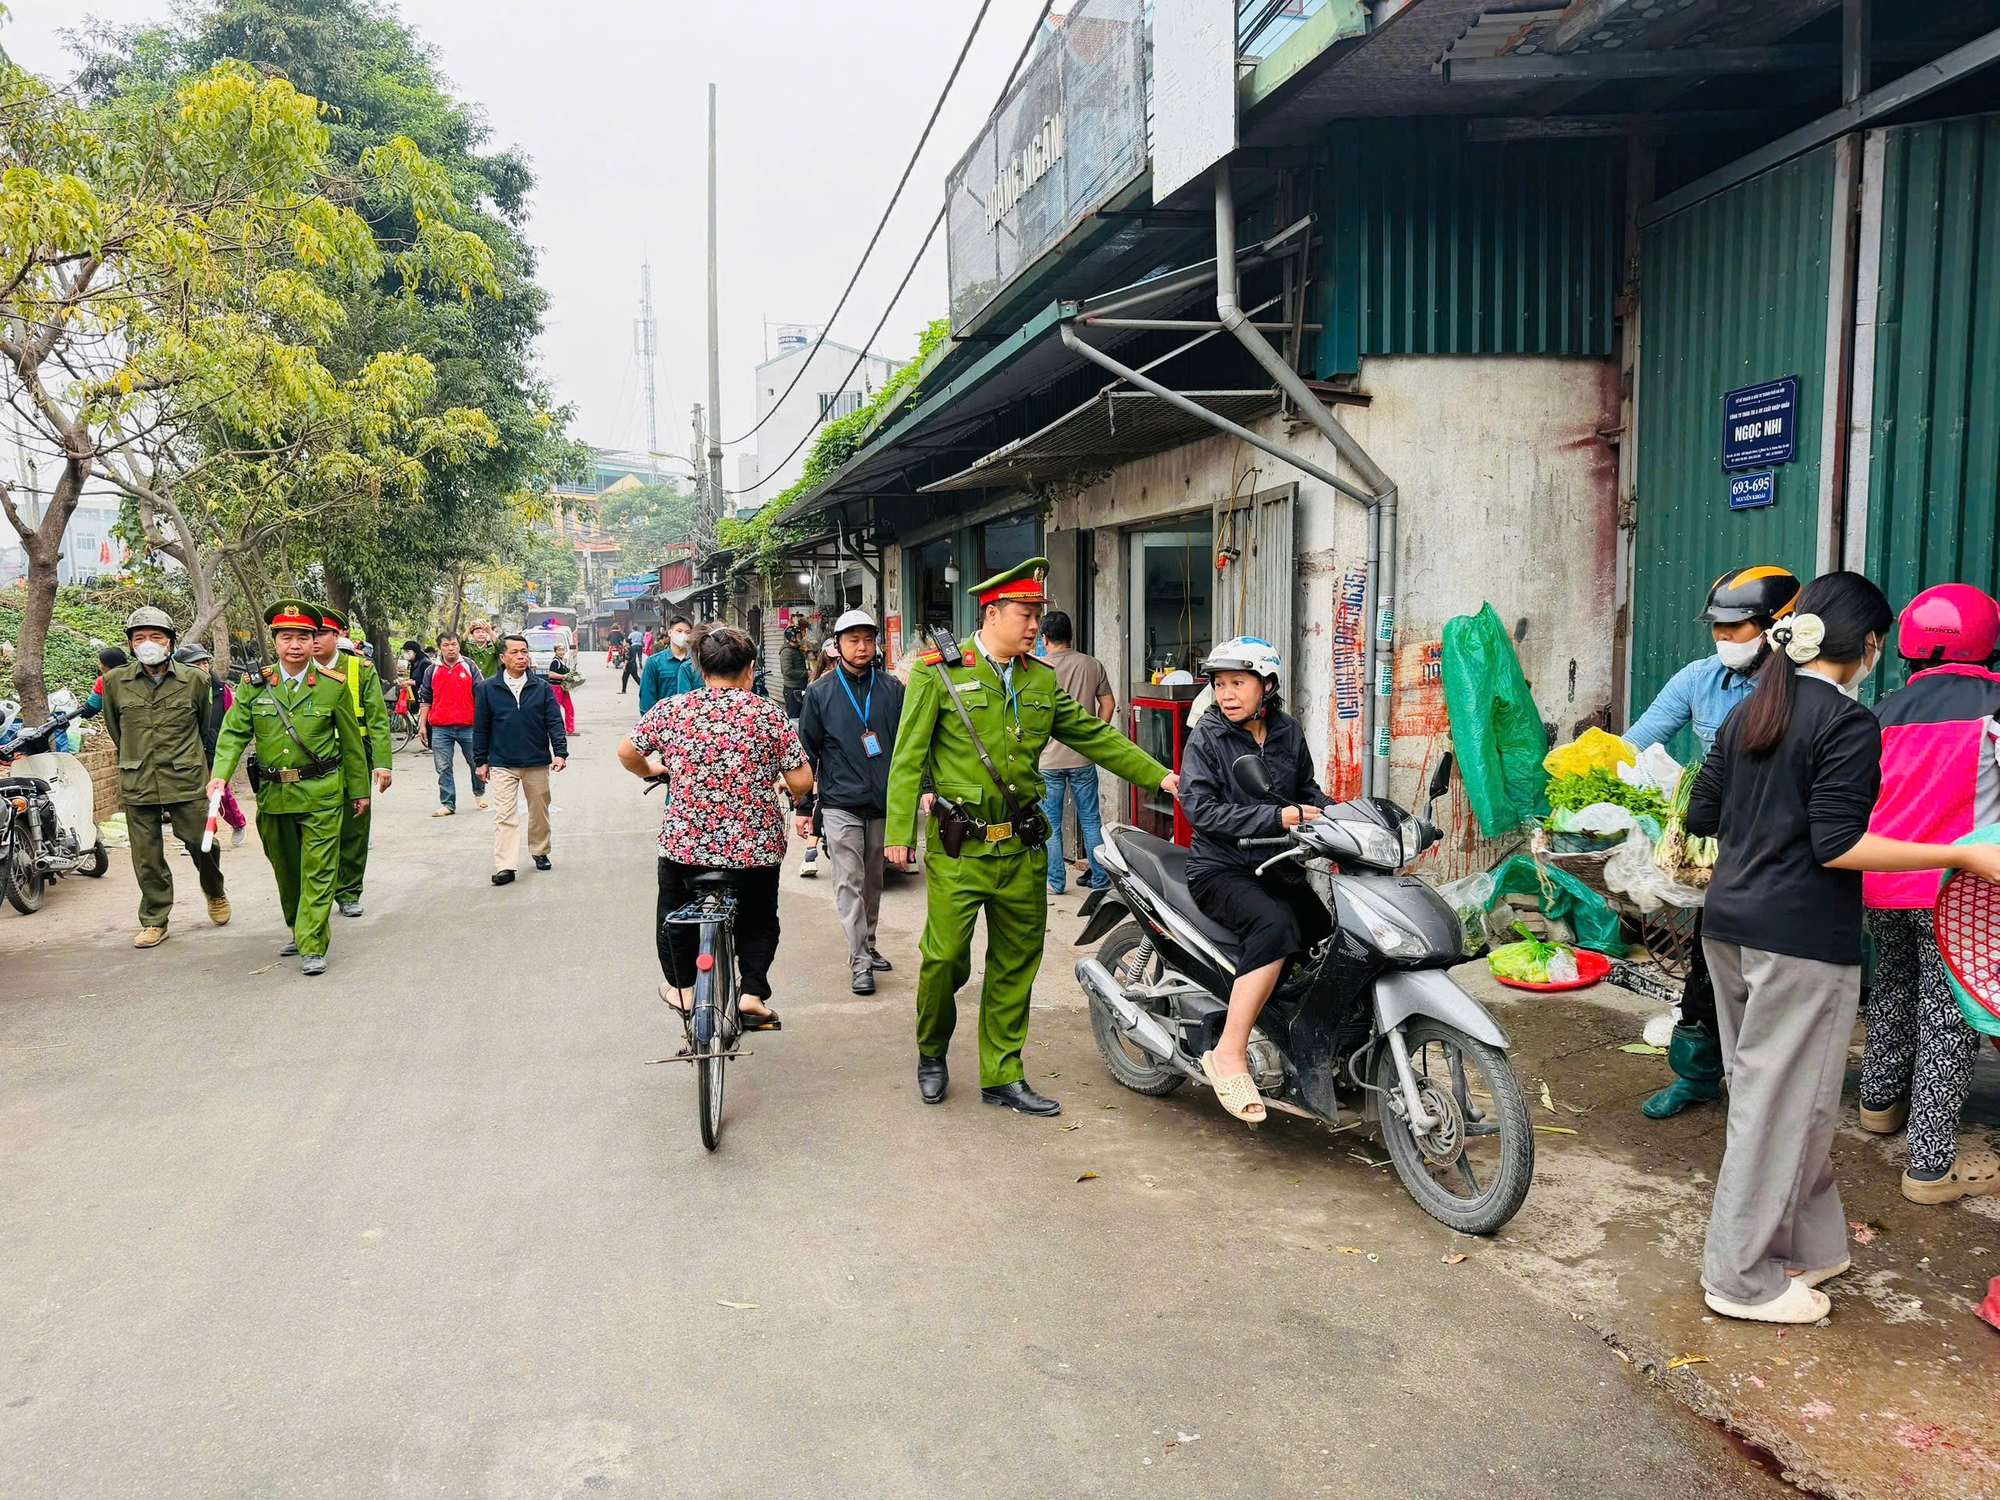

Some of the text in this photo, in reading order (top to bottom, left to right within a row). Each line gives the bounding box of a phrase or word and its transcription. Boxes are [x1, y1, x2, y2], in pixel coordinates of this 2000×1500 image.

[1023, 112, 1063, 192] NGÂN
[1735, 418, 1782, 443] NGỌC NHỊ
[1733, 477, 1770, 495] 693-695
[1925, 627, 1961, 635] HONDA
[1337, 947, 1367, 963] HONDA
